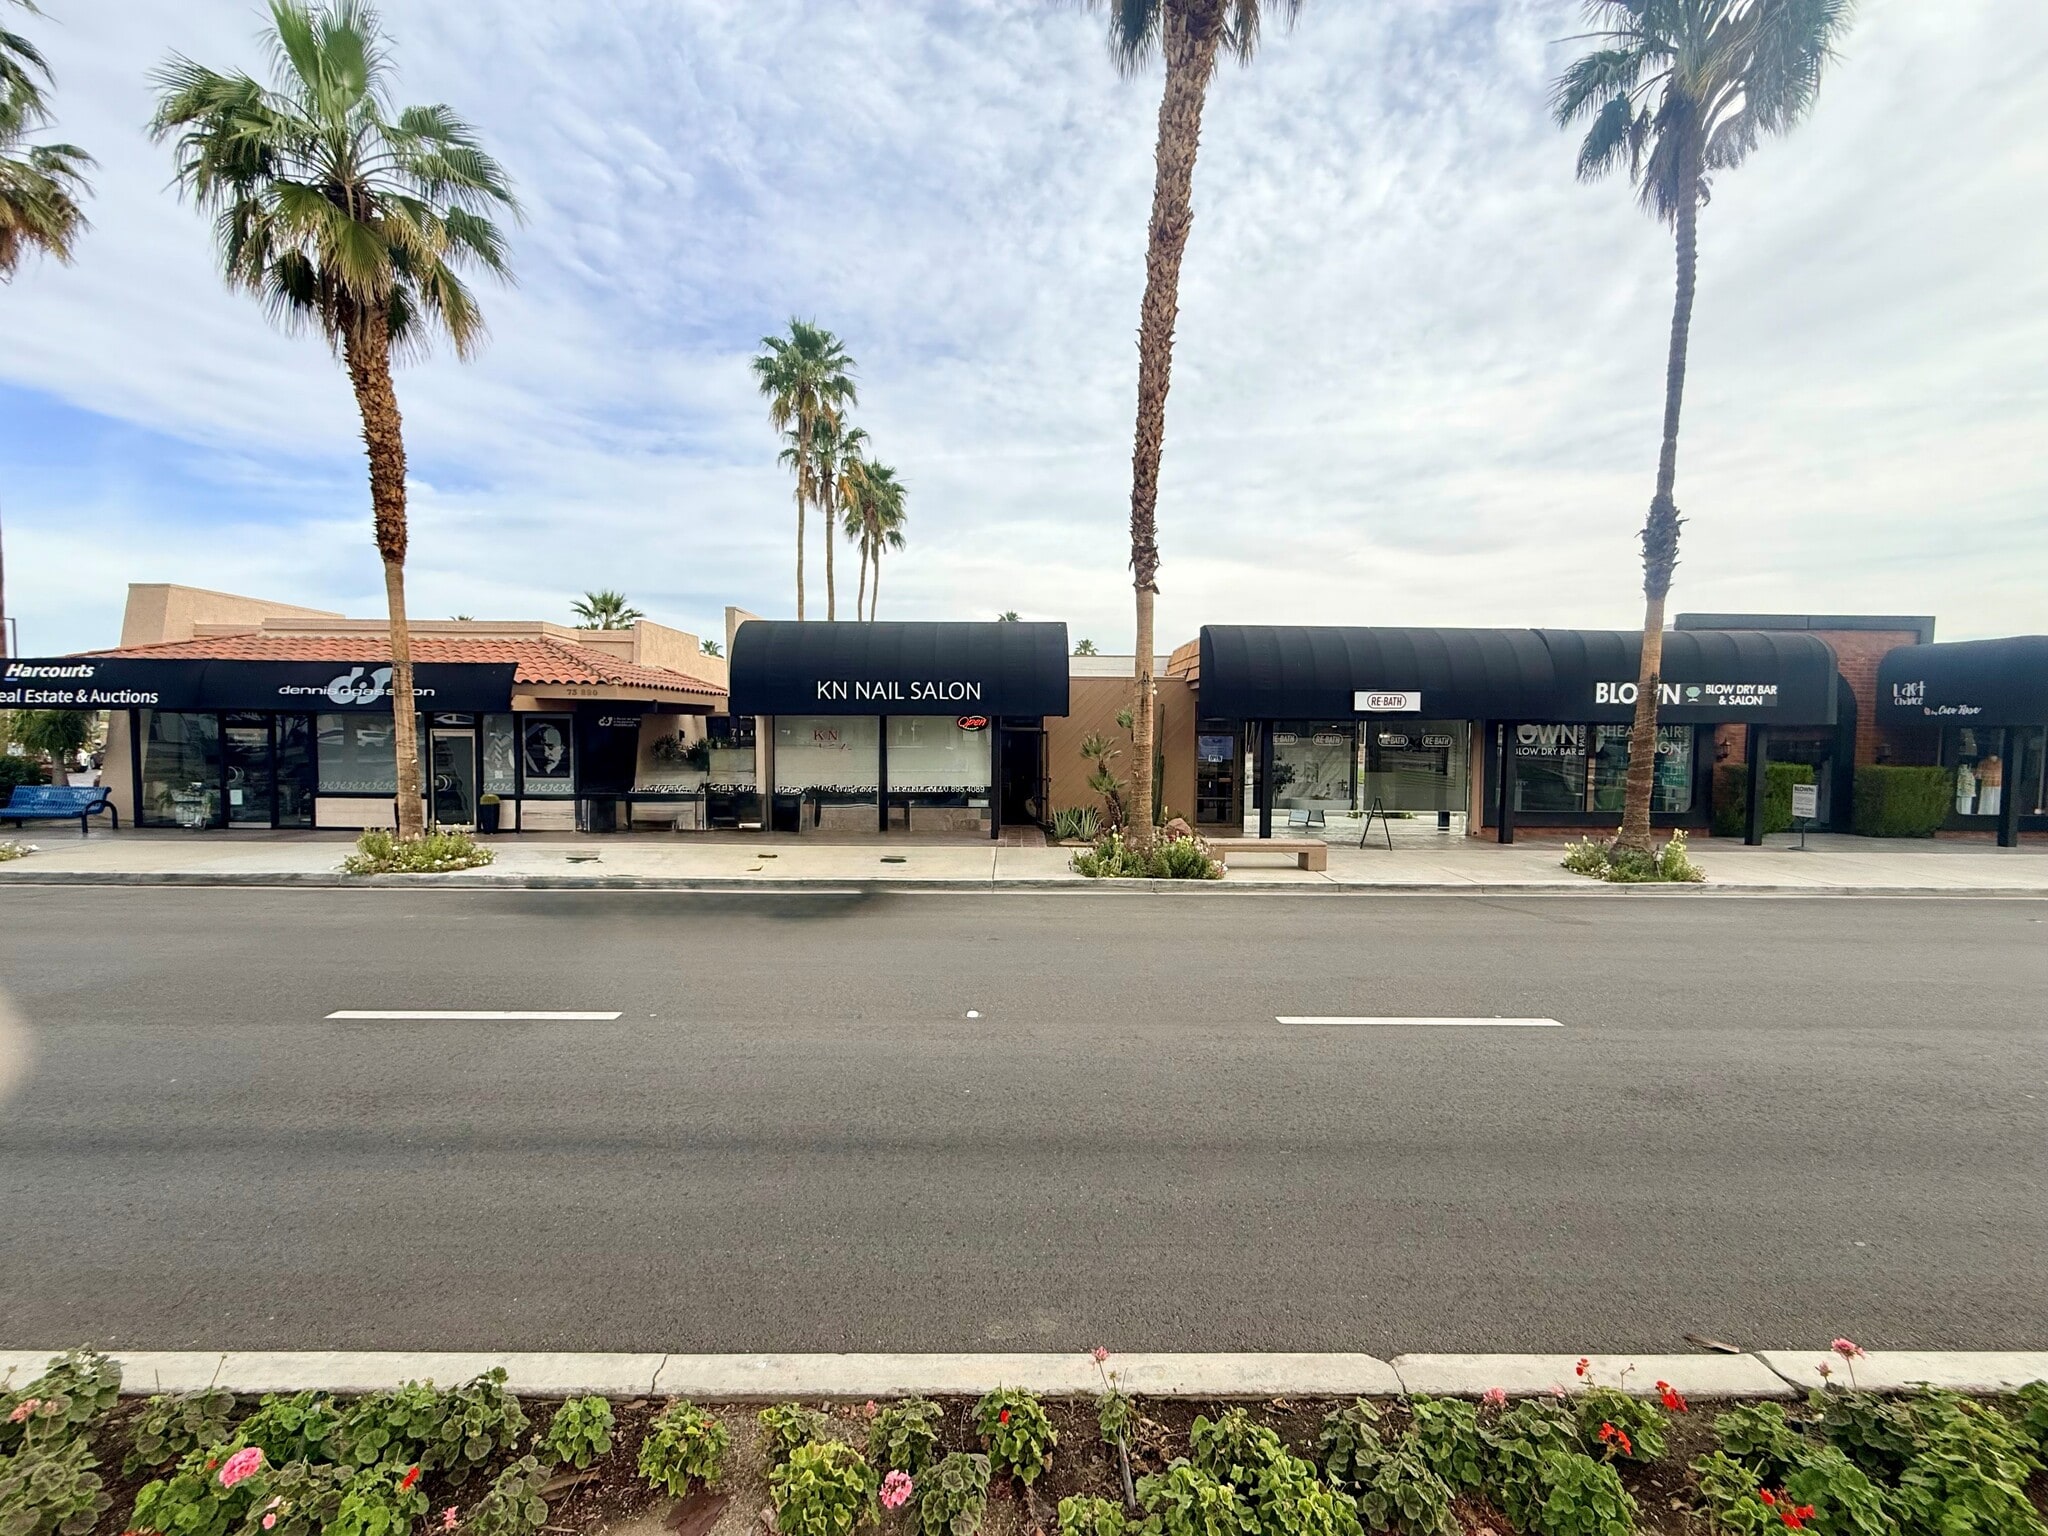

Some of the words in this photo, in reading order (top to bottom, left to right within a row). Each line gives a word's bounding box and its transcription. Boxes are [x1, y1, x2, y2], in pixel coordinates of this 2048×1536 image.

[5, 663, 95, 677] Harcourts
[278, 685, 338, 695] dennis
[386, 688, 436, 697] son
[816, 681, 847, 700] KN
[855, 681, 904, 700] NAIL
[910, 681, 981, 700] SALON
[1595, 682, 1680, 704] BLON
[1705, 684, 1735, 694] BLOW
[1736, 684, 1756, 694] DRY
[1757, 685, 1777, 694] BAR
[0, 689, 21, 703] eal
[25, 689, 74, 703] Estate
[76, 689, 88, 703] &
[89, 689, 159, 704] Auctions
[1371, 697, 1402, 706] RE-BATH
[1718, 695, 1727, 705] &
[1728, 695, 1763, 705] SALON
[958, 716, 986, 728] Open
[814, 730, 838, 741] KN
[1516, 724, 1579, 745] OWN
[1598, 725, 1634, 738] SHEA
[1655, 725, 1682, 738] AIR
[1627, 741, 1681, 754] DIGN
